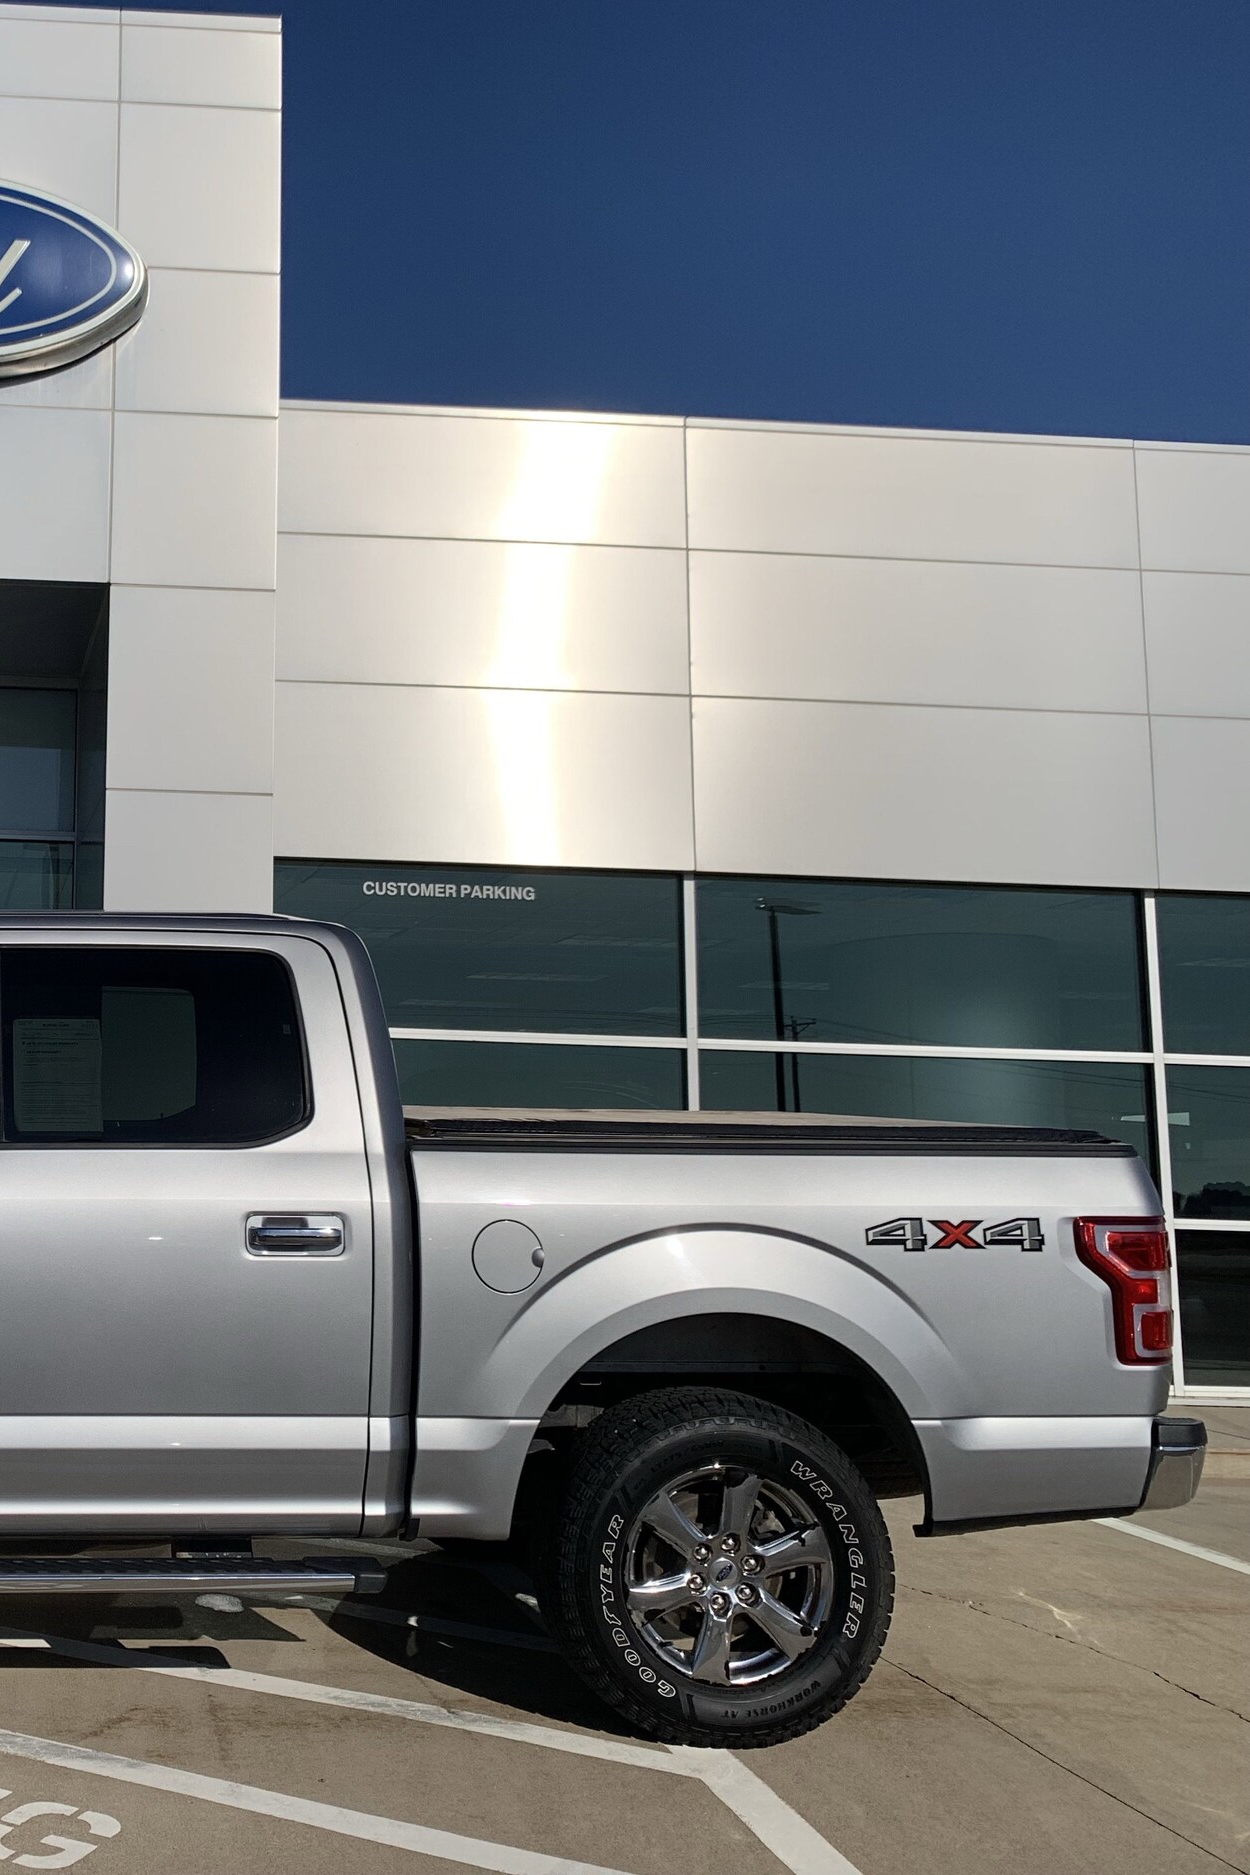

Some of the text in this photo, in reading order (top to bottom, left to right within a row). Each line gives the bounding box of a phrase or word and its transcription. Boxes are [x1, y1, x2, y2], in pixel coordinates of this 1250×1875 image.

[362, 881, 535, 900] CUSTOMER PARKING
[790, 1460, 867, 1639] WRANGLER
[600, 1514, 676, 1698] GOODYEAR
[746, 1680, 822, 1717] WORKHORSE
